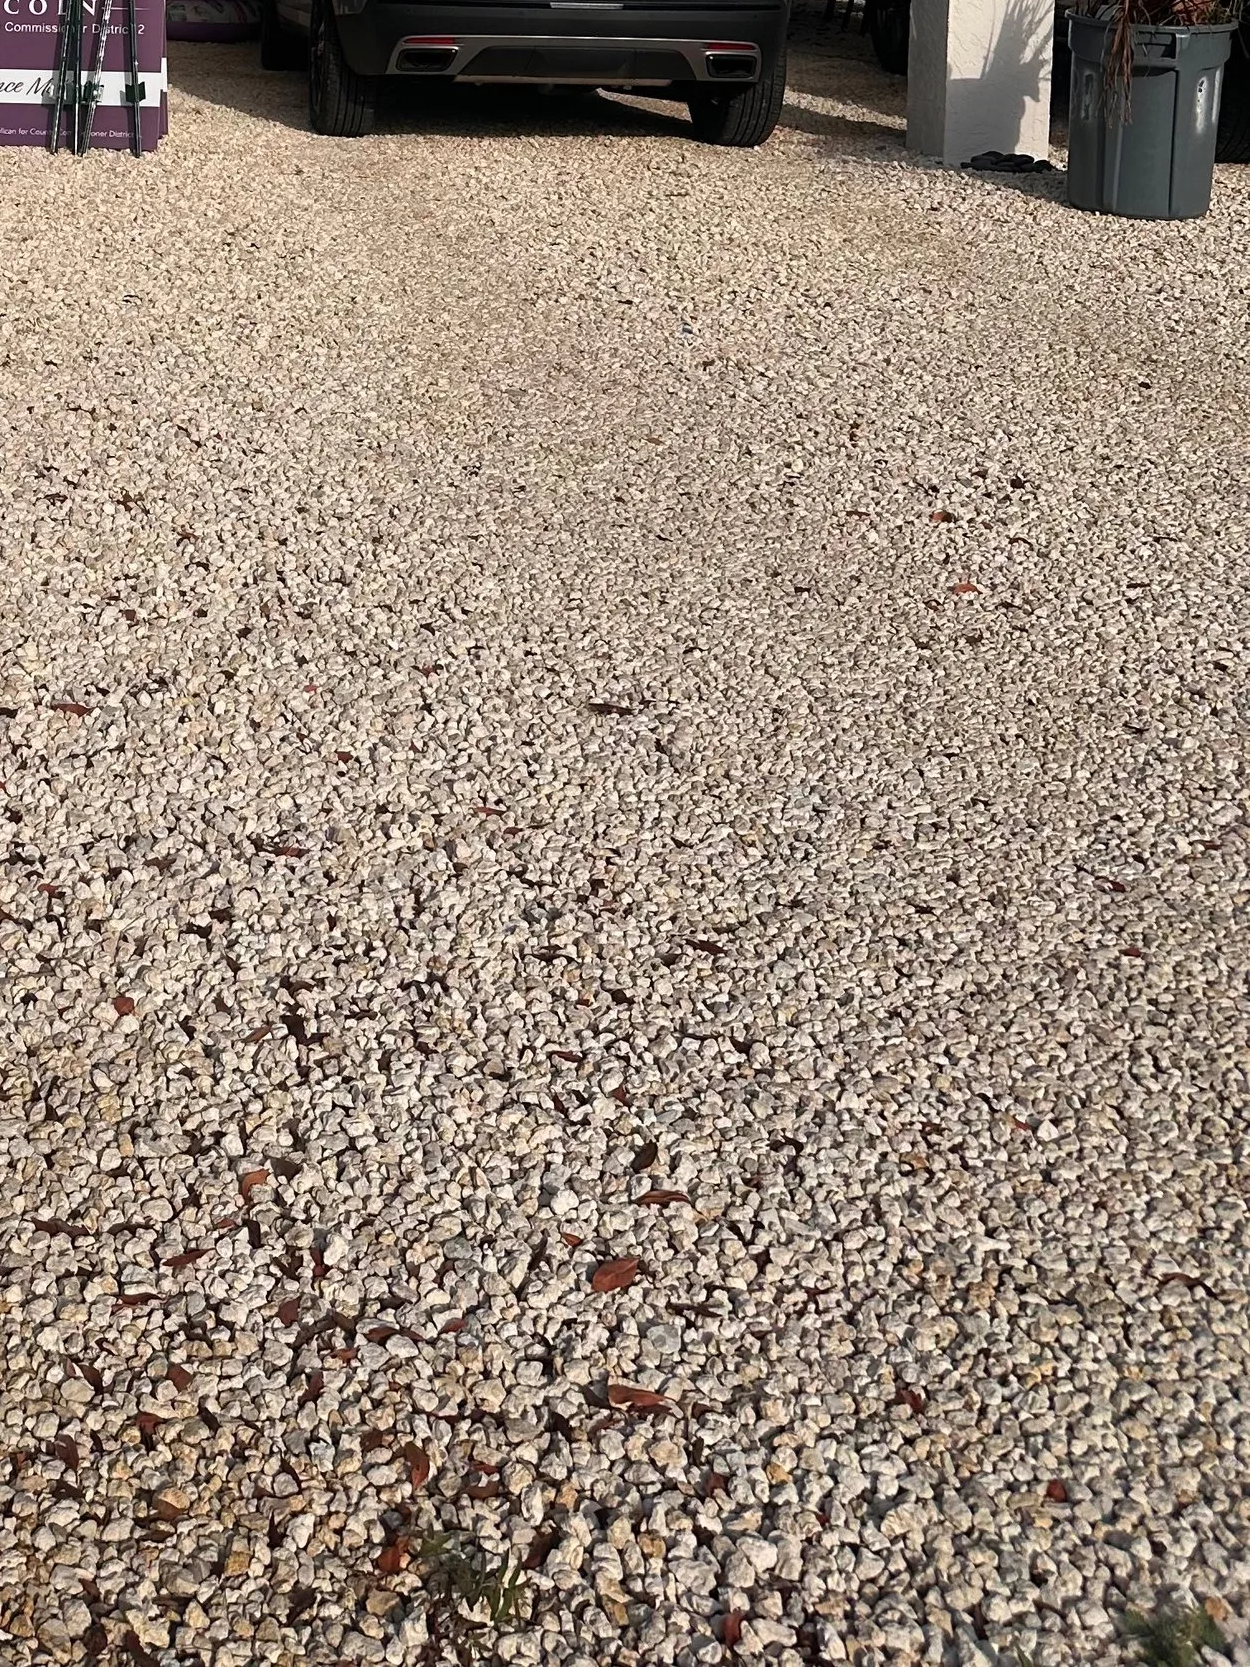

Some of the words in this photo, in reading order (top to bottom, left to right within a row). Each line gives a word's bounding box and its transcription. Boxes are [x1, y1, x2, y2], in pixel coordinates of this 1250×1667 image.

[92, 23, 134, 35] Dstric
[137, 23, 146, 35] 2
[18, 127, 29, 135] for
